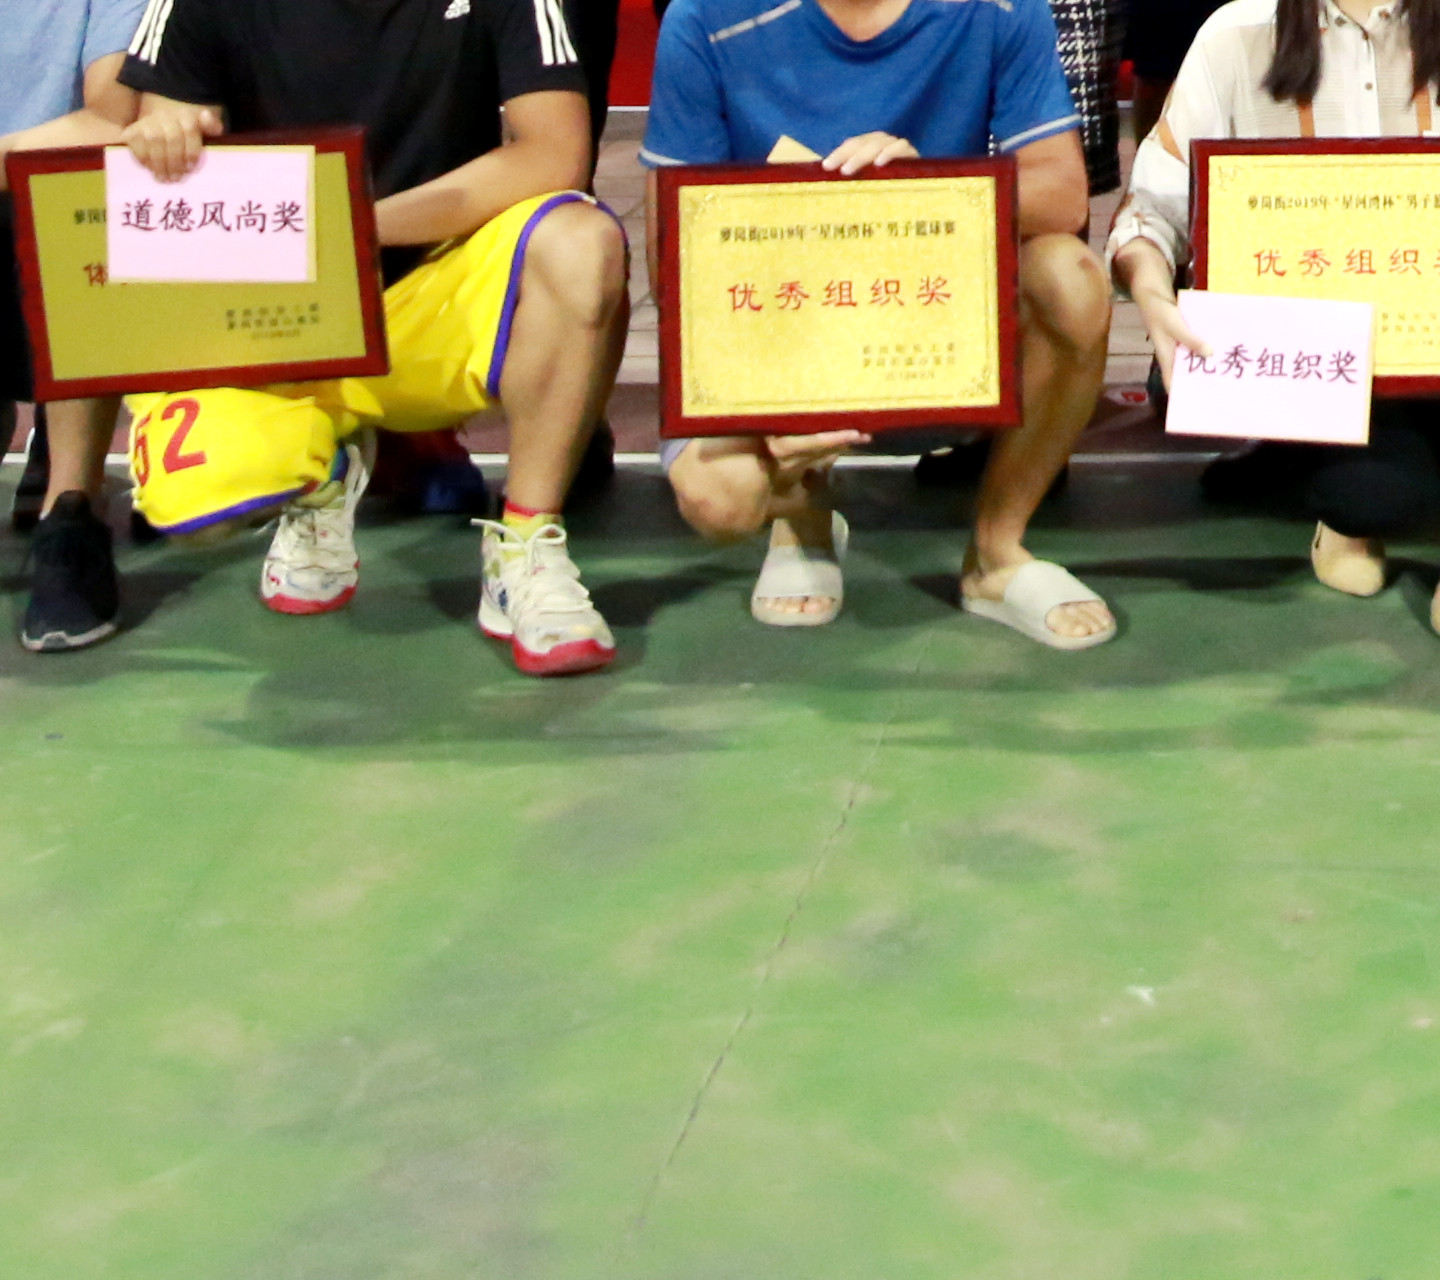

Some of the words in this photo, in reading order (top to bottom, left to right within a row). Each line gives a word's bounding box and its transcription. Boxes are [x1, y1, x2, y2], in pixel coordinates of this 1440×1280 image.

[120, 198, 306, 233] 道德风尚奖
[727, 275, 954, 312] 优秀组织奖
[1183, 342, 1359, 384] 优秀组织奖
